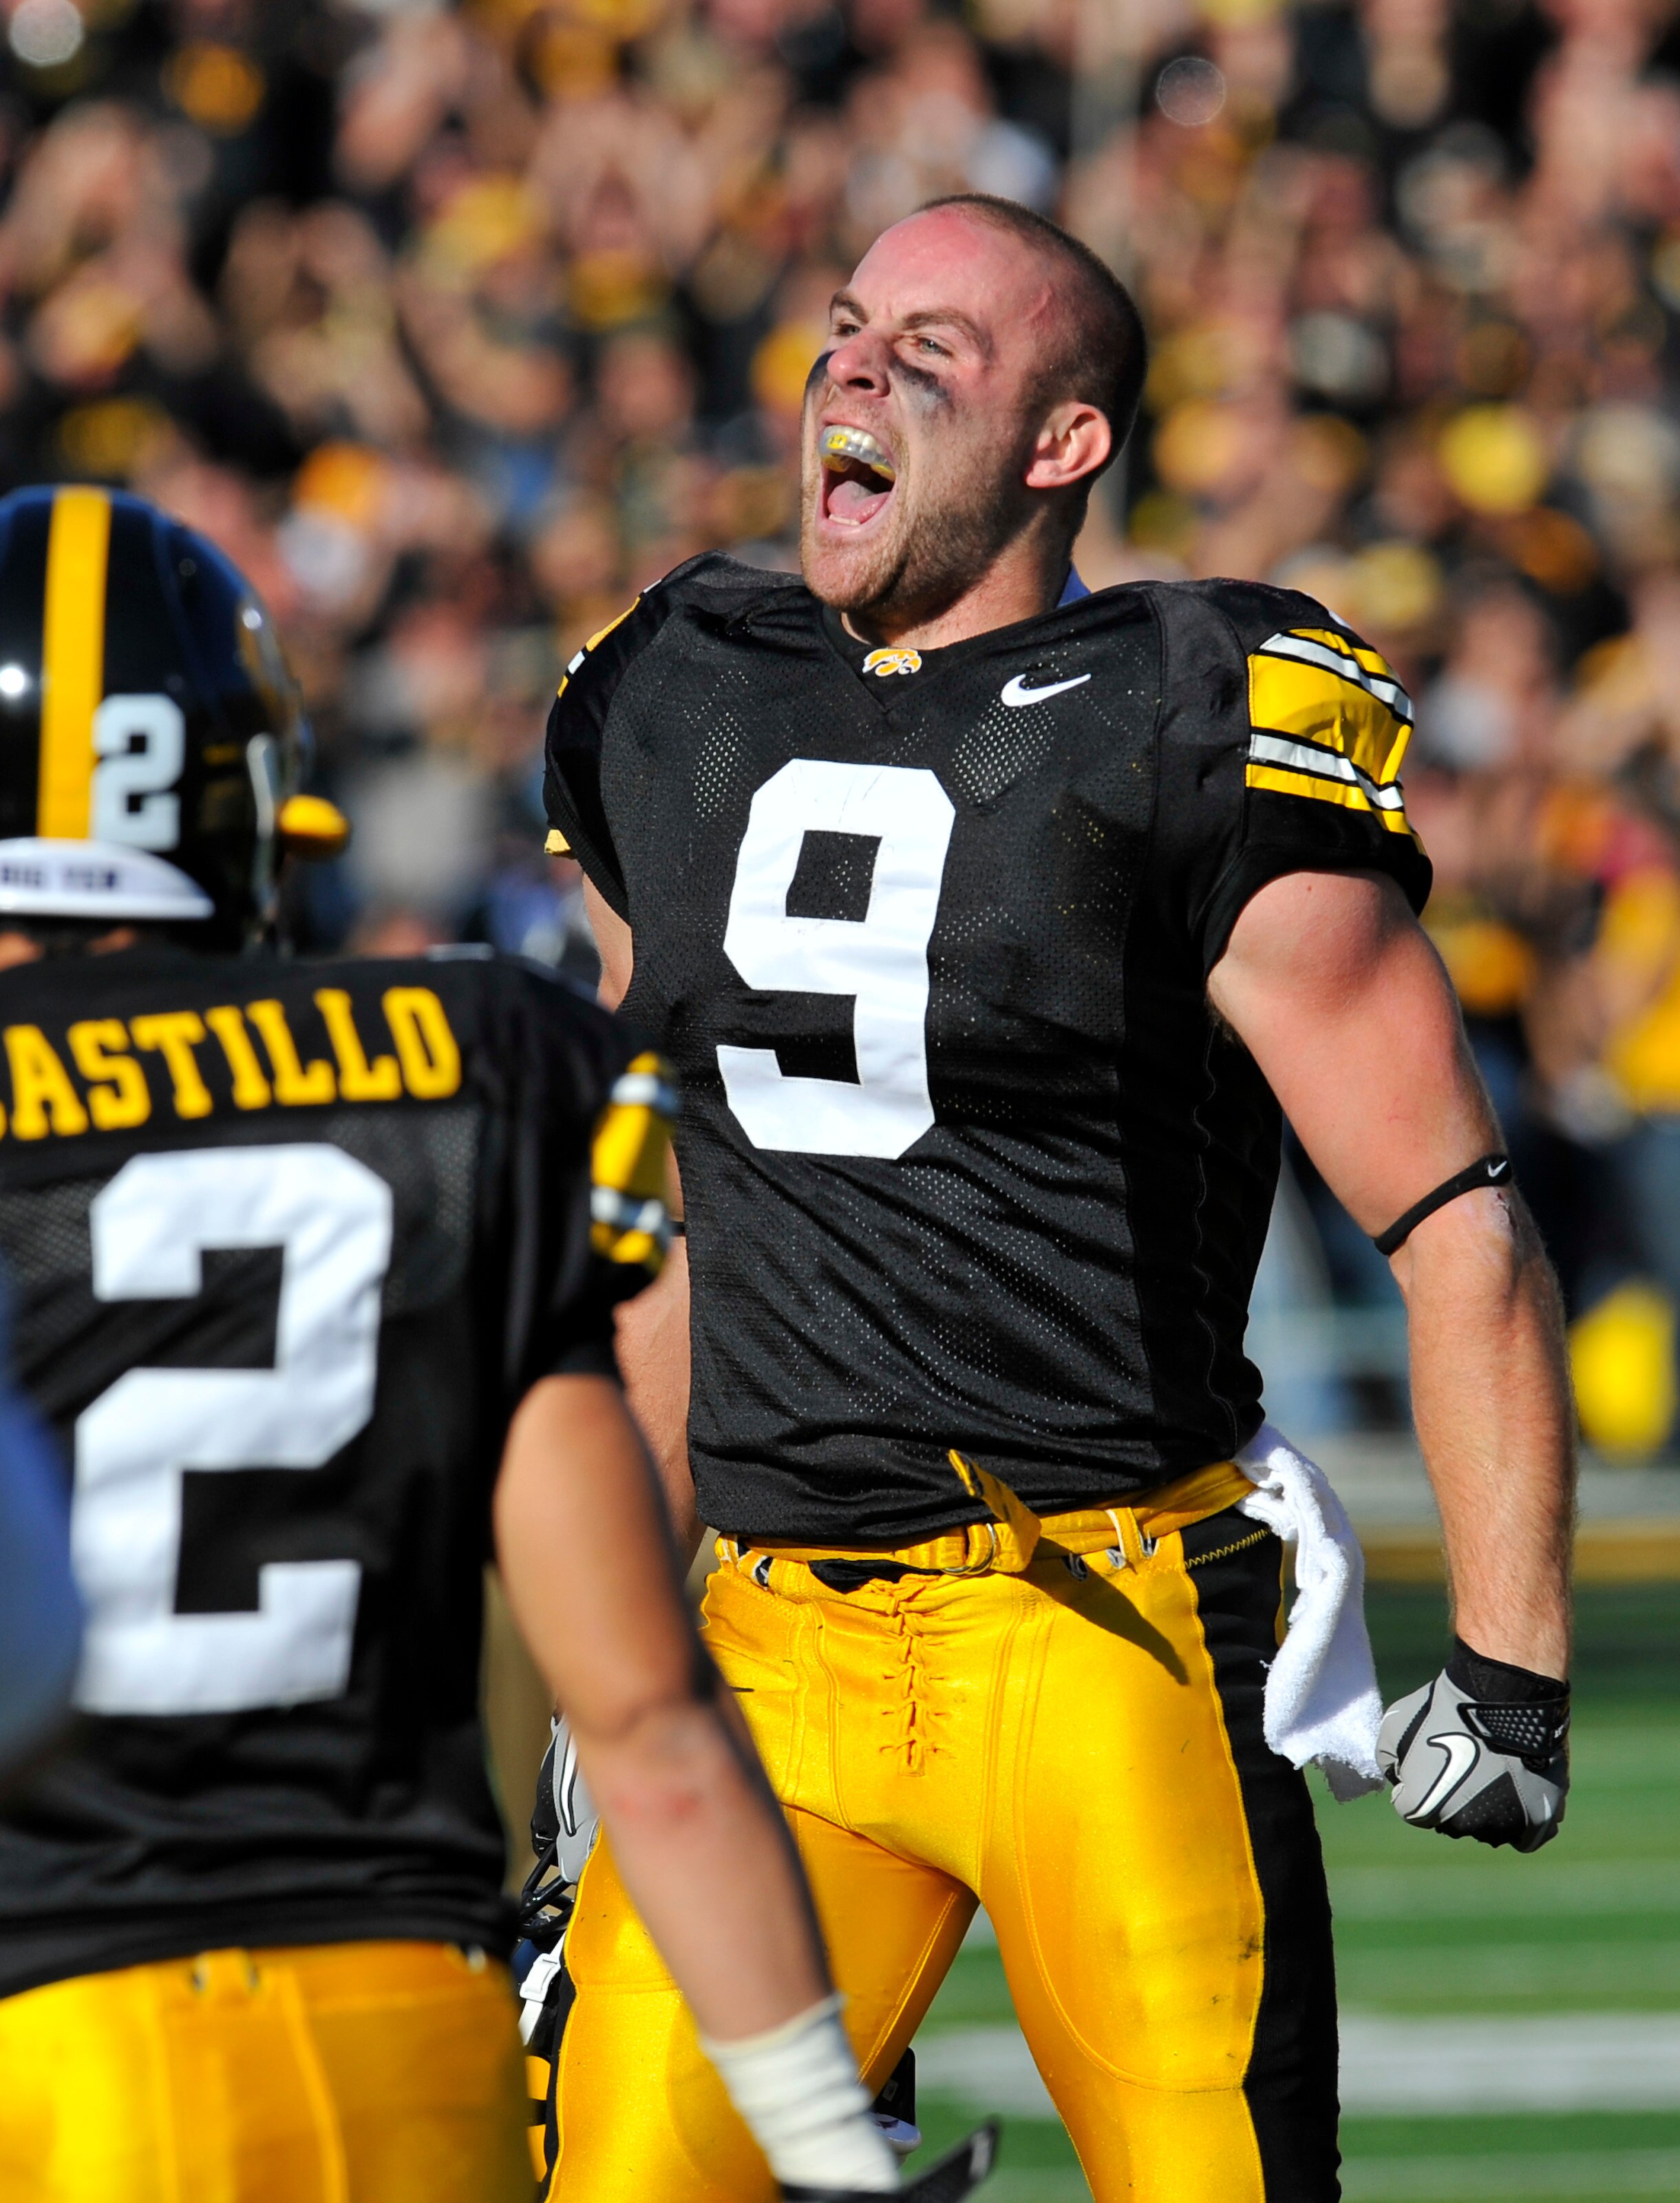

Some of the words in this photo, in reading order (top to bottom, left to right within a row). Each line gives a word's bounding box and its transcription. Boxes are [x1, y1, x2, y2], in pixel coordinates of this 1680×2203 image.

[91, 693, 185, 851] 2
[0, 987, 460, 1140] ASTILLO
[716, 758, 956, 1160] 9
[72, 1143, 392, 1714] 2
